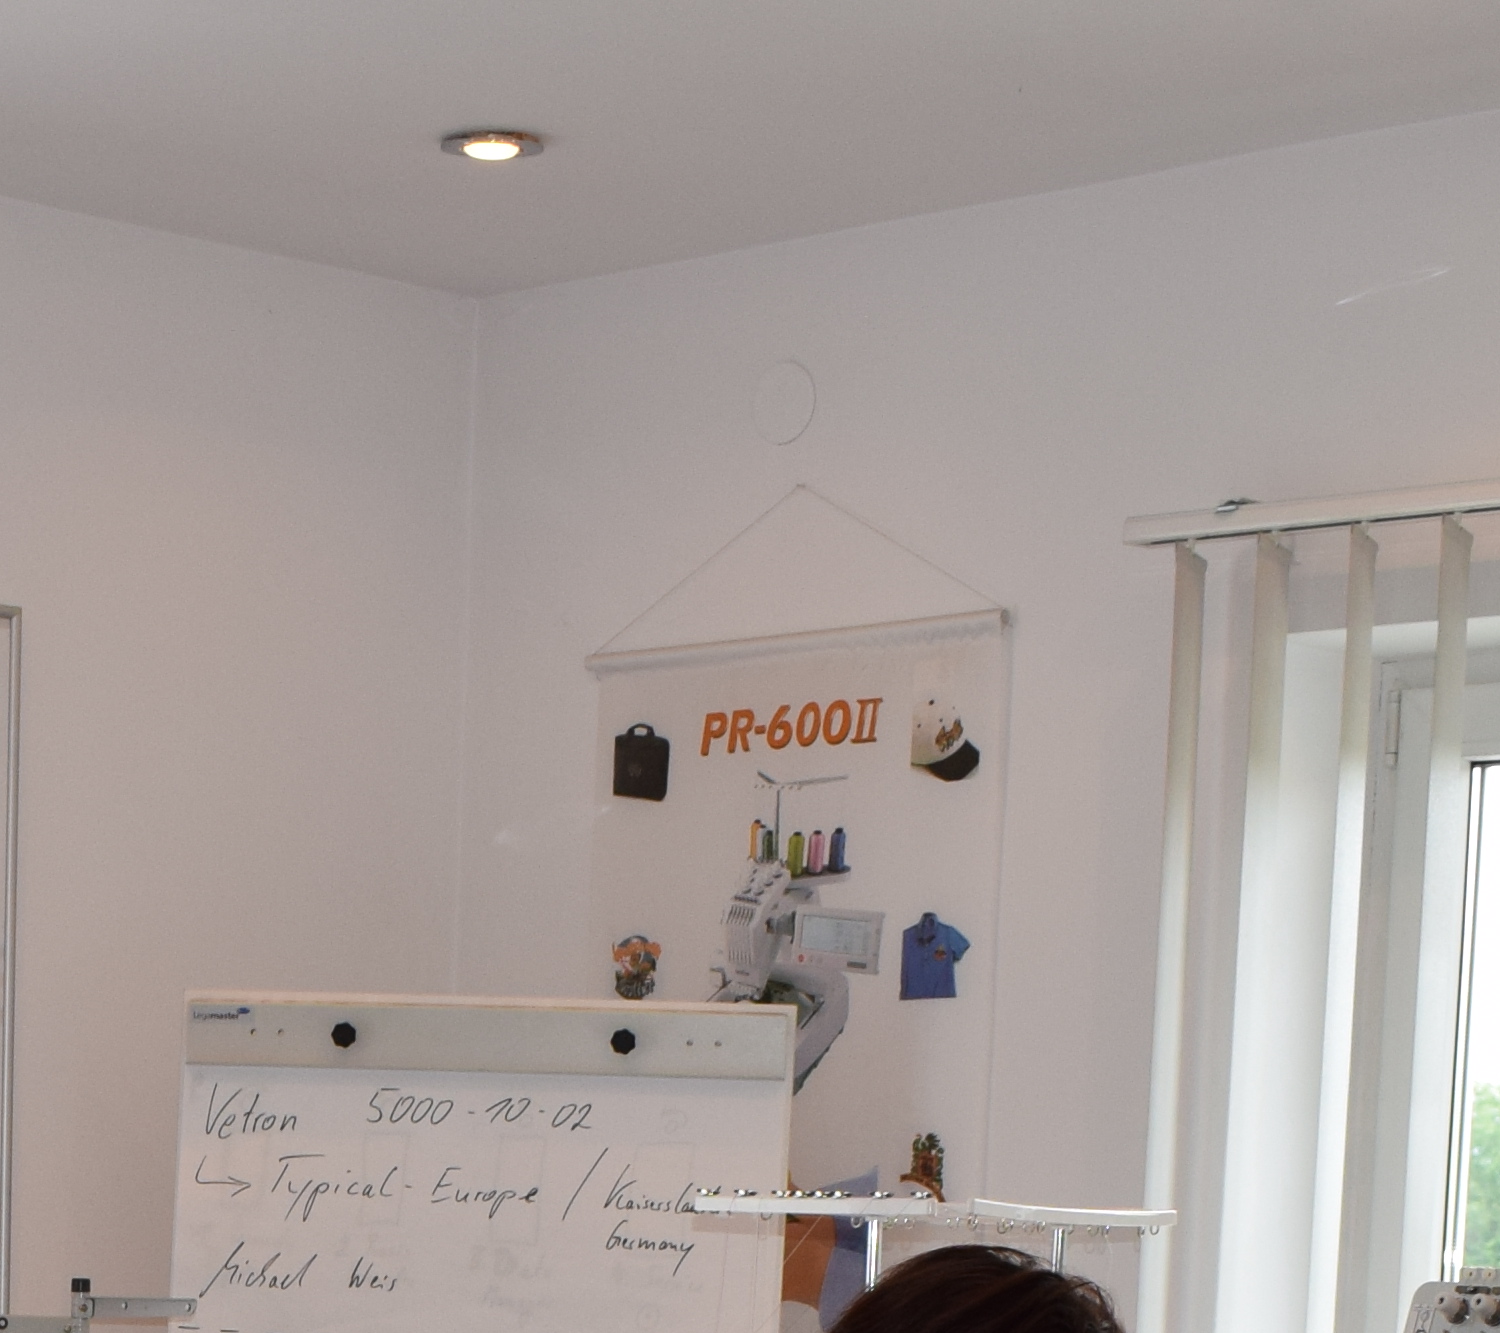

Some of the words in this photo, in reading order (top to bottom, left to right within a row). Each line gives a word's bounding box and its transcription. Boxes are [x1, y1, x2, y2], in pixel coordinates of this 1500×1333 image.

[203, 1081, 299, 1142] Vetron
[199, 1241, 318, 1299] Michael
[605, 1219, 695, 1277] Germany
